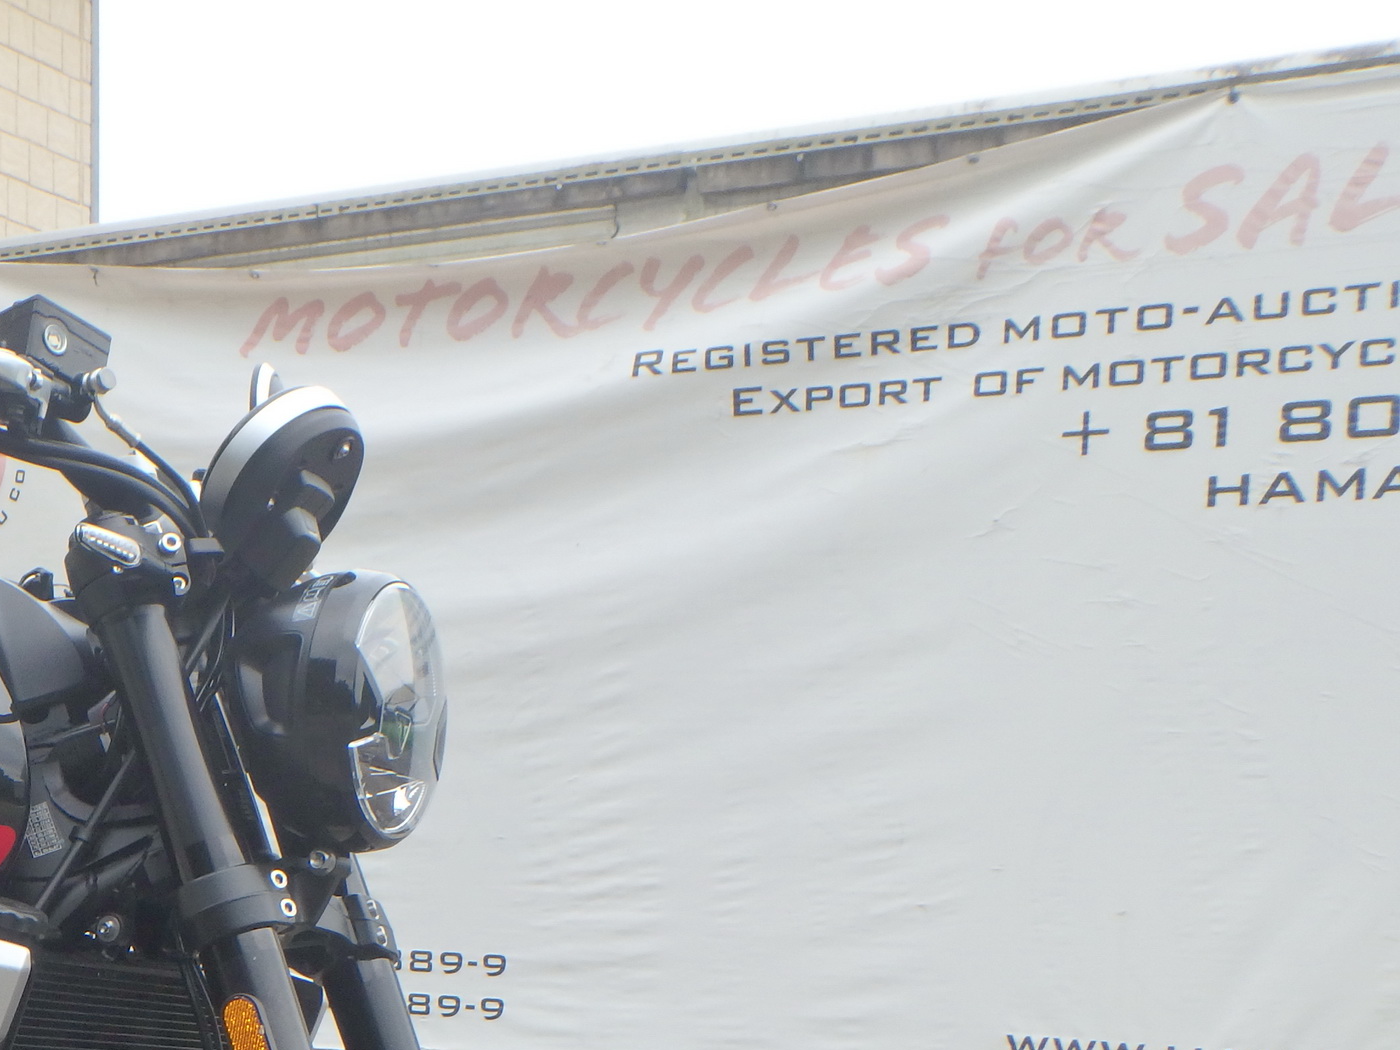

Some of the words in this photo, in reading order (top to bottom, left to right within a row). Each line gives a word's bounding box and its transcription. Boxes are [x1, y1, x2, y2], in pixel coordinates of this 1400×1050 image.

[238, 213, 952, 357] MOTORCYCLES
[632, 322, 981, 377] REGISTERED
[733, 376, 943, 418] EXPORT
[973, 367, 1045, 398] OF
[1061, 338, 1396, 391] MOTORCYC
[1144, 406, 1229, 452] 81
[1278, 394, 1400, 444] 80
[396, 949, 506, 976] 89-9
